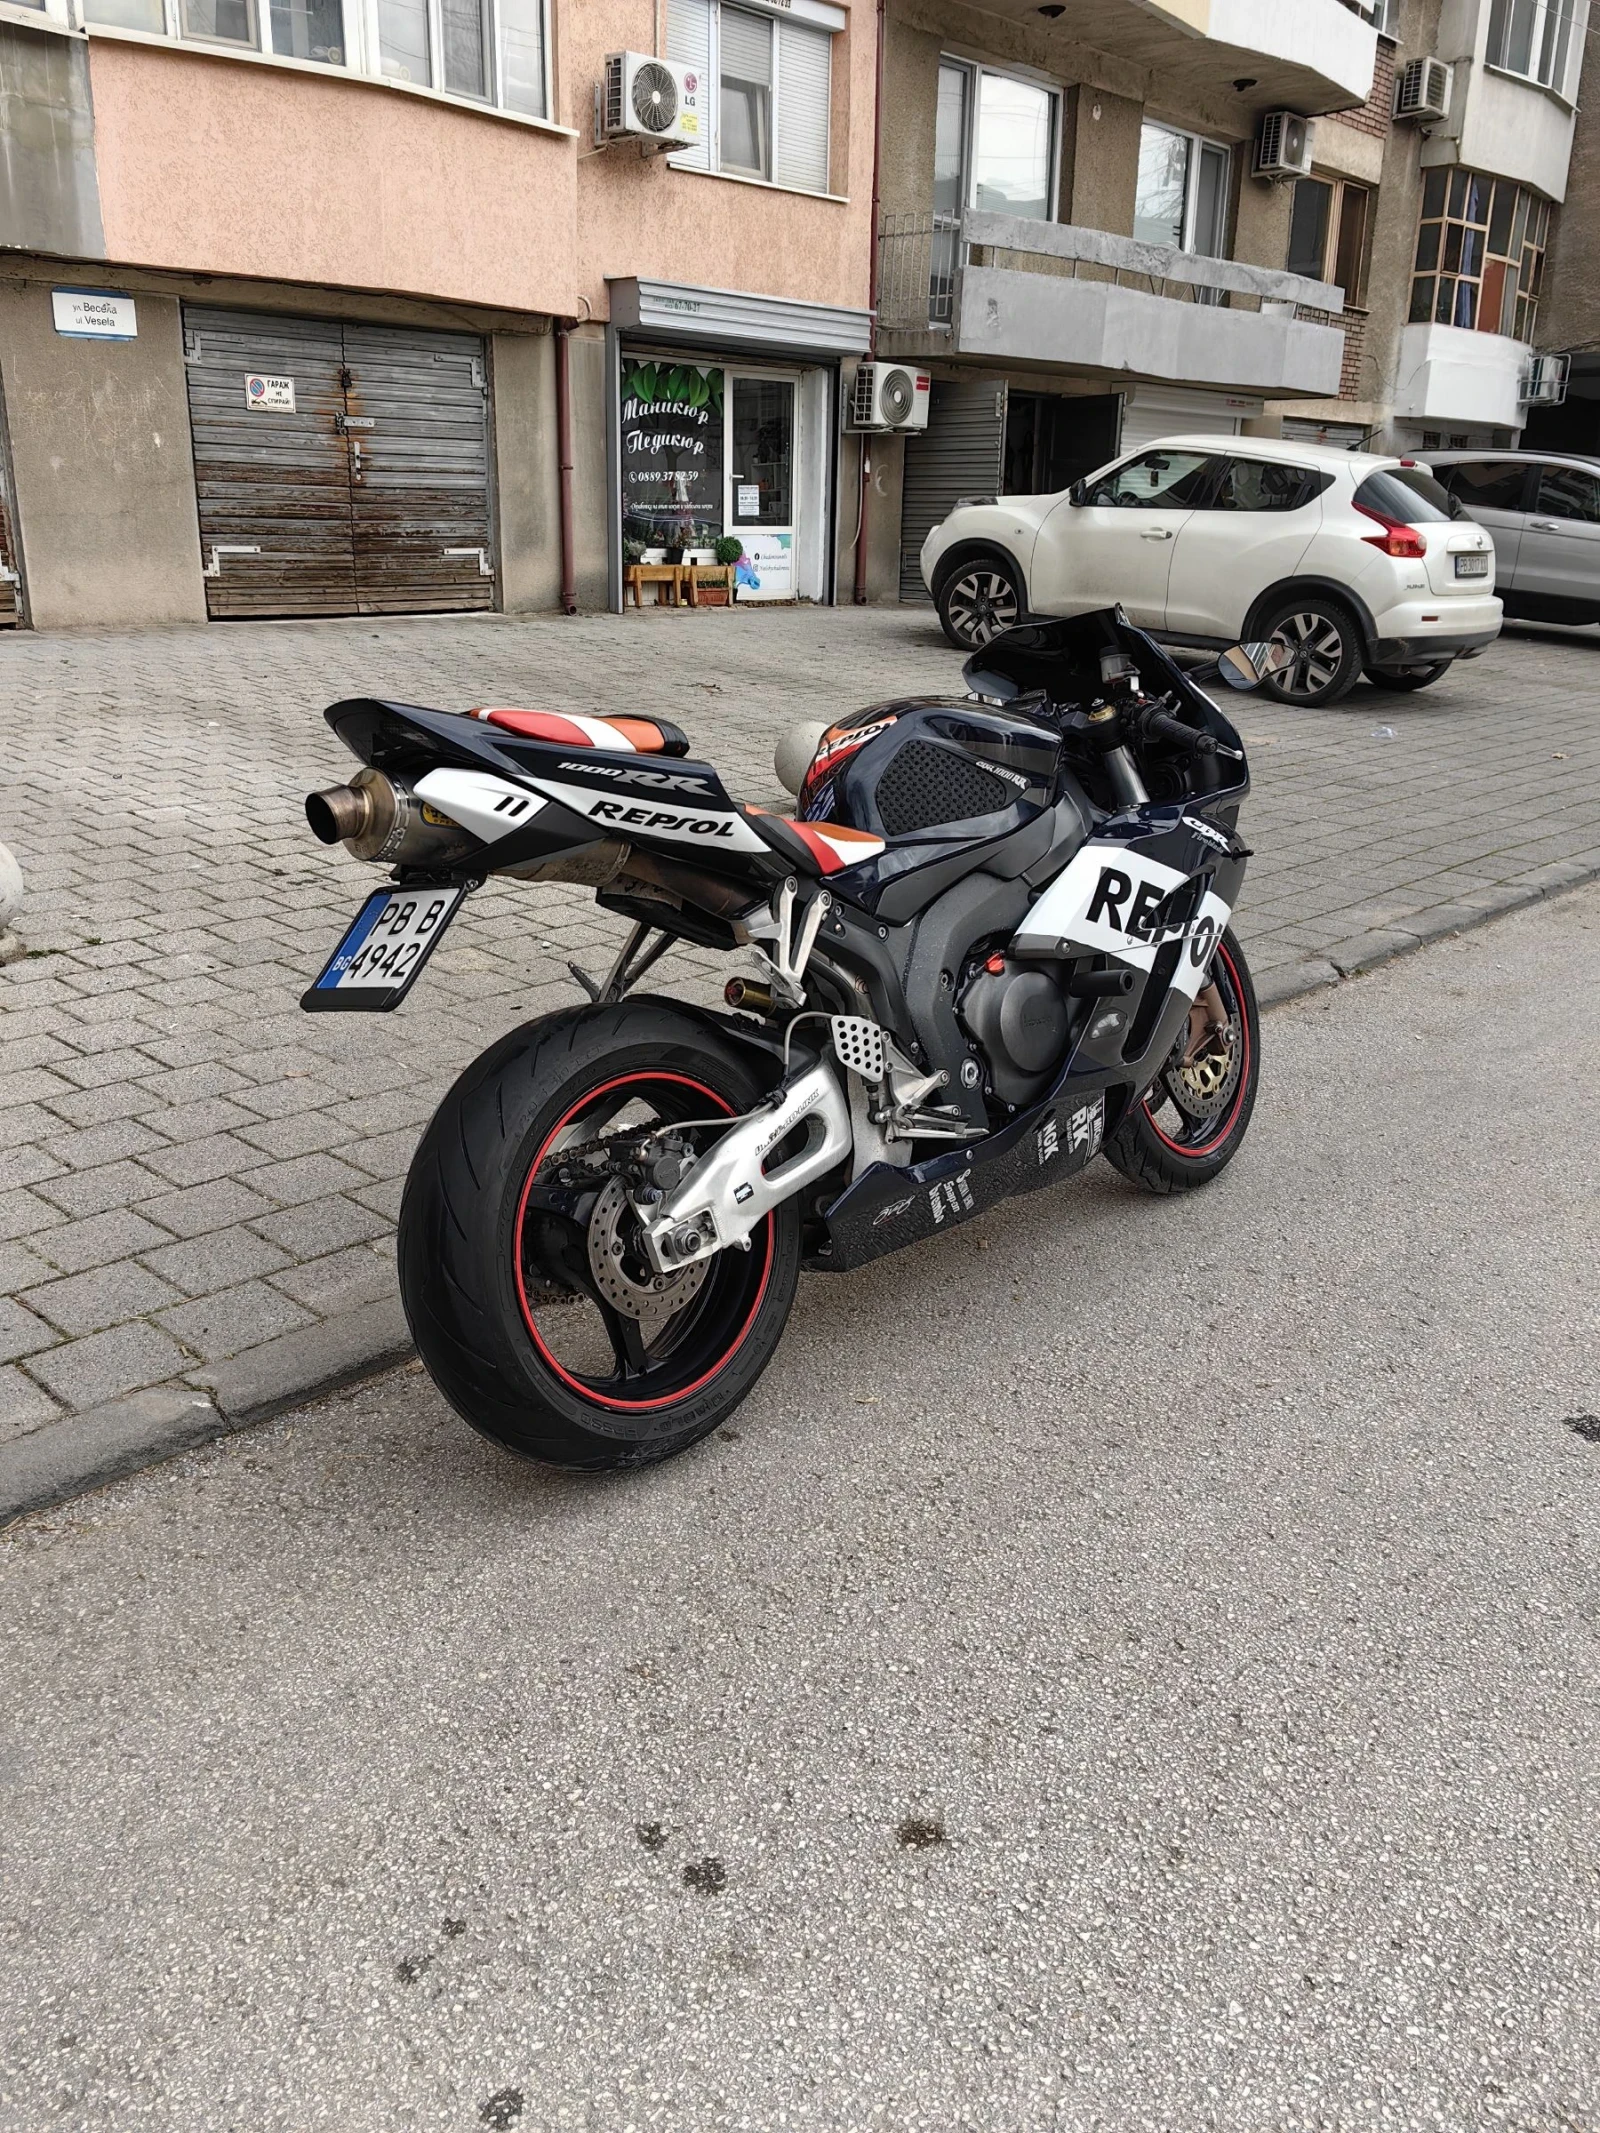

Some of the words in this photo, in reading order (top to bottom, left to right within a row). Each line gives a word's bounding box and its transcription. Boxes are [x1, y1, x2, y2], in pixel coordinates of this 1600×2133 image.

[685, 95, 696, 106] LG
[84, 315, 116, 327] Vesela
[267, 380, 290, 389] ГАРАЖ
[621, 397, 709, 425] Маникюр
[626, 429, 705, 455] Педикюр
[588, 800, 735, 837] REPSOL
[1181, 816, 1231, 853] CBR
[332, 956, 352, 971] BG
[348, 942, 421, 979] 4942
[1043, 1118, 1059, 1161] NGK
[1072, 1106, 1088, 1150] RK
[928, 1182, 947, 1224] brembo
[943, 1180, 960, 1213] Snap-on
